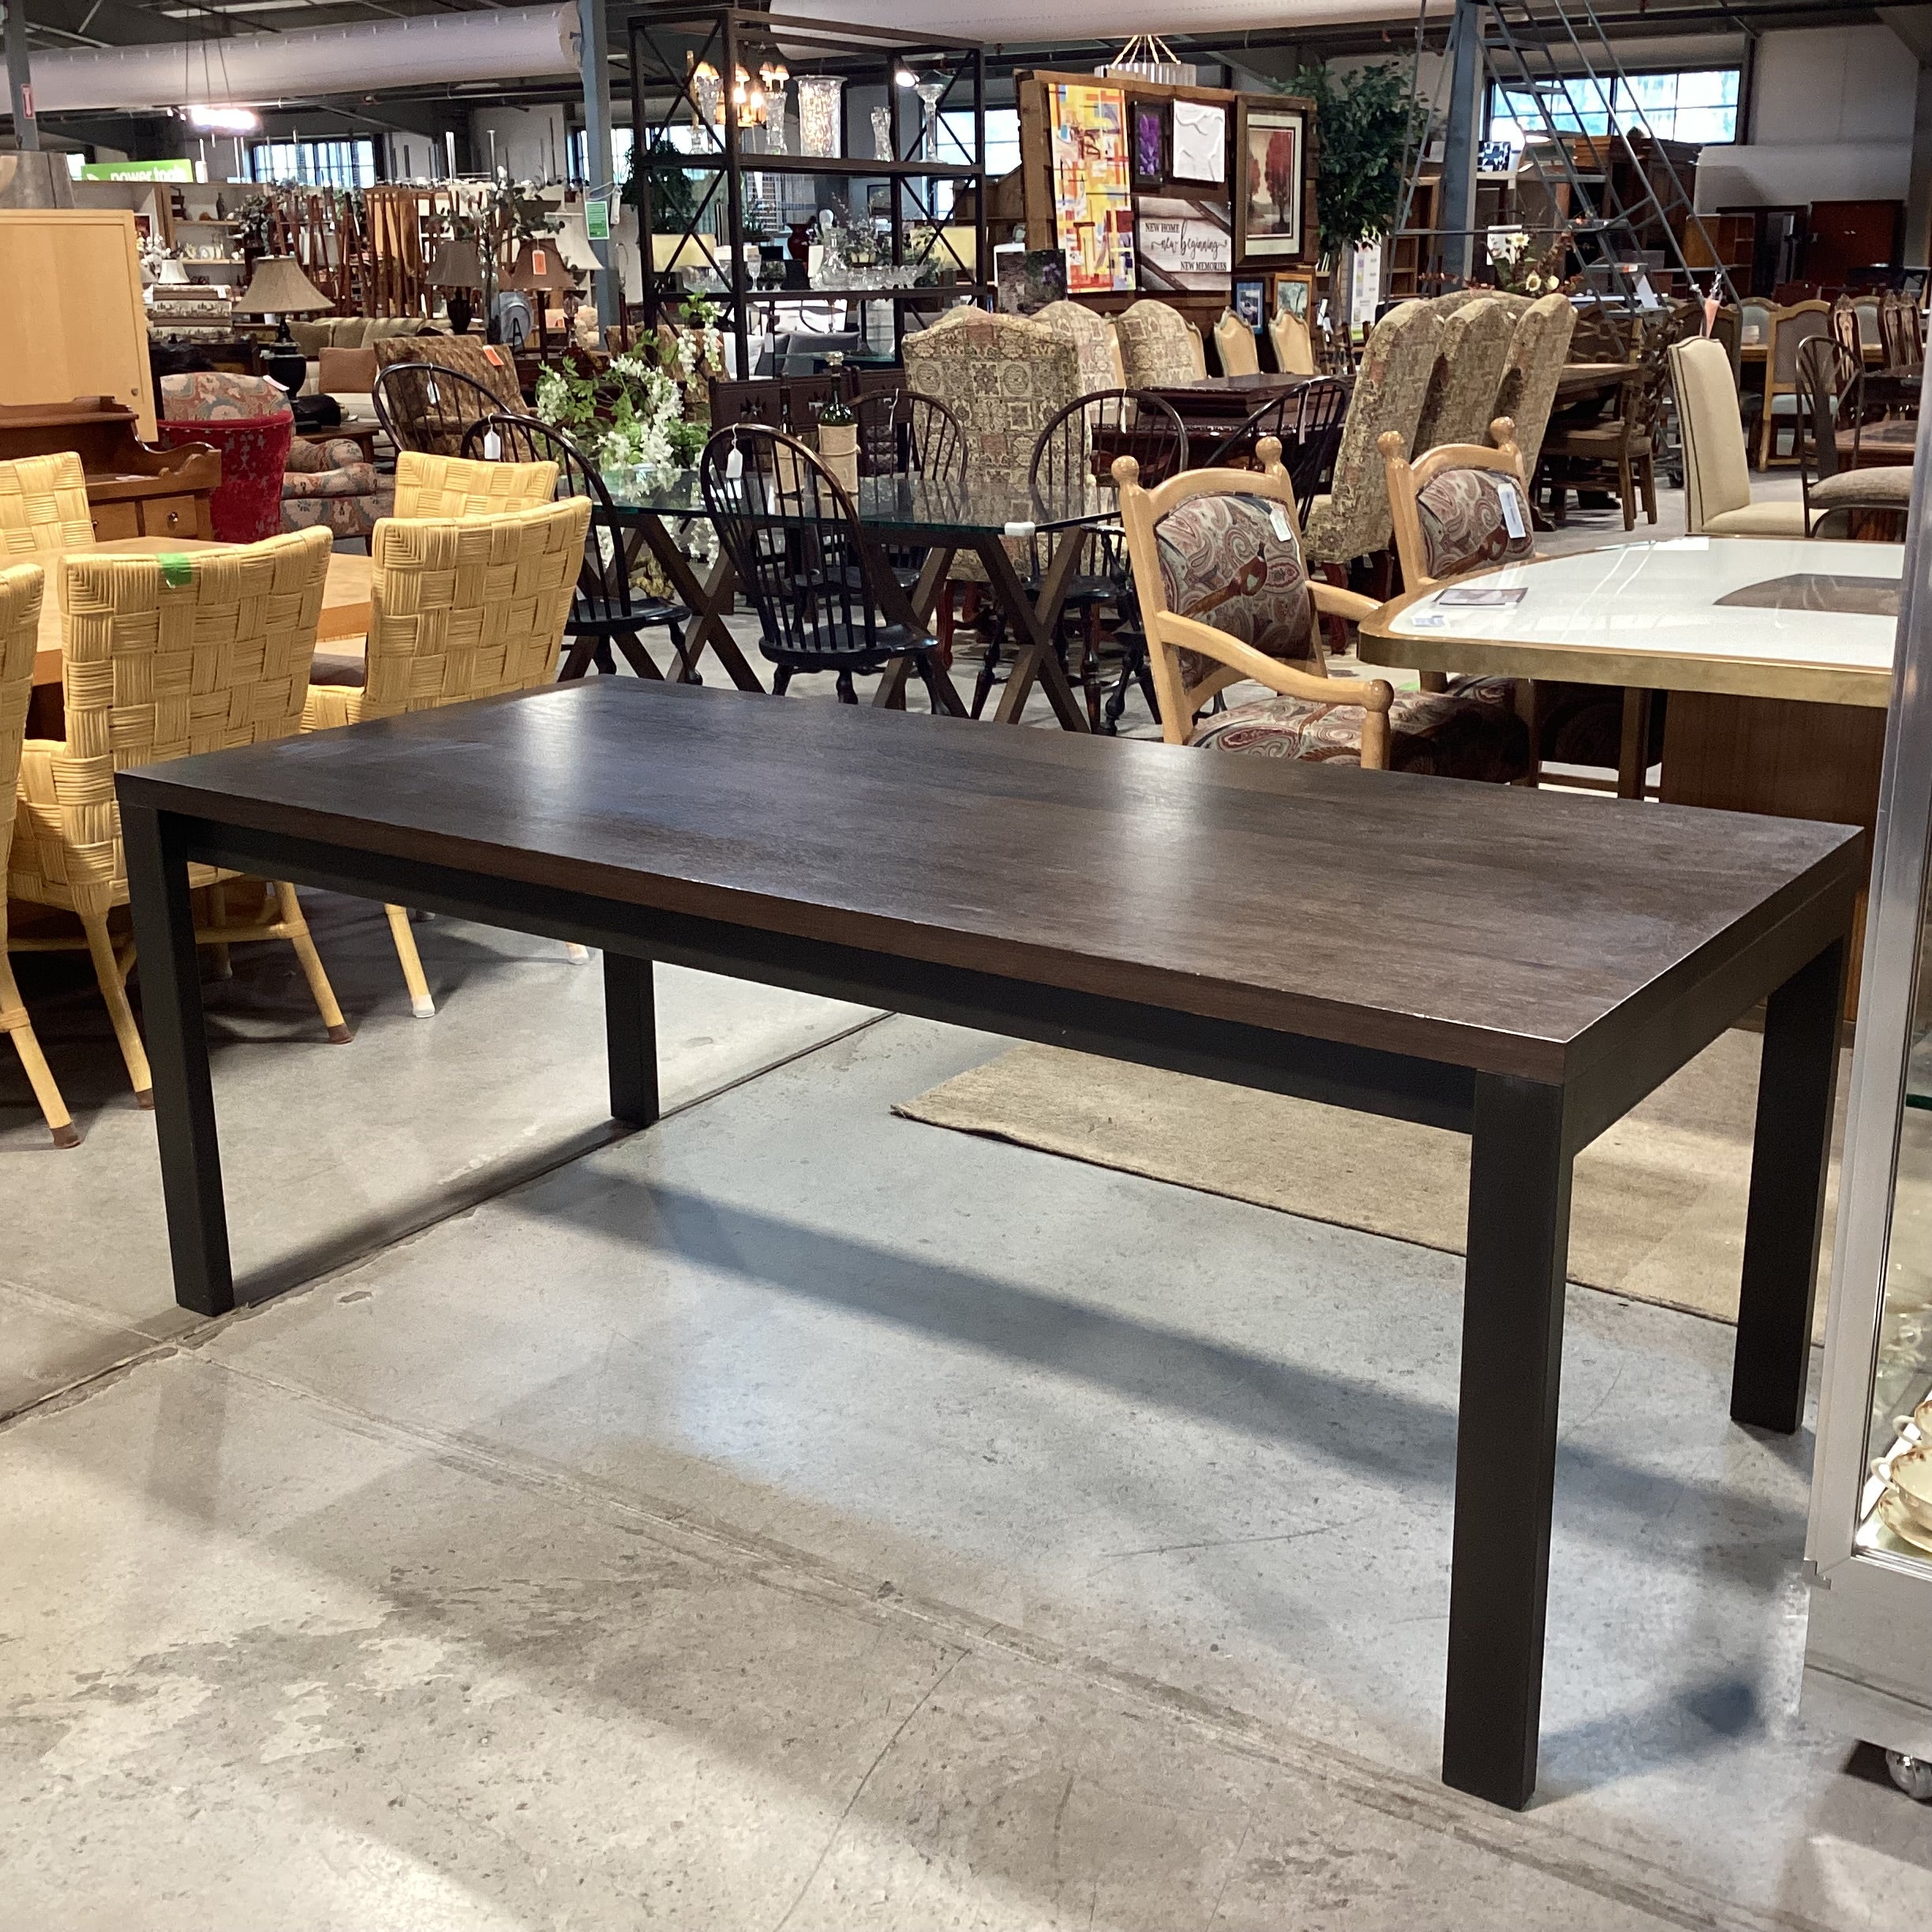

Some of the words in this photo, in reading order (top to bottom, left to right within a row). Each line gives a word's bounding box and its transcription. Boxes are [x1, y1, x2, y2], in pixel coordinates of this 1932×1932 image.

[1145, 223, 1160, 232] NEW
[1161, 223, 1180, 233] HOME
[1181, 220, 1221, 260] beginning
[1181, 261, 1195, 271] NEW
[1196, 262, 1227, 271] MEMORIES
